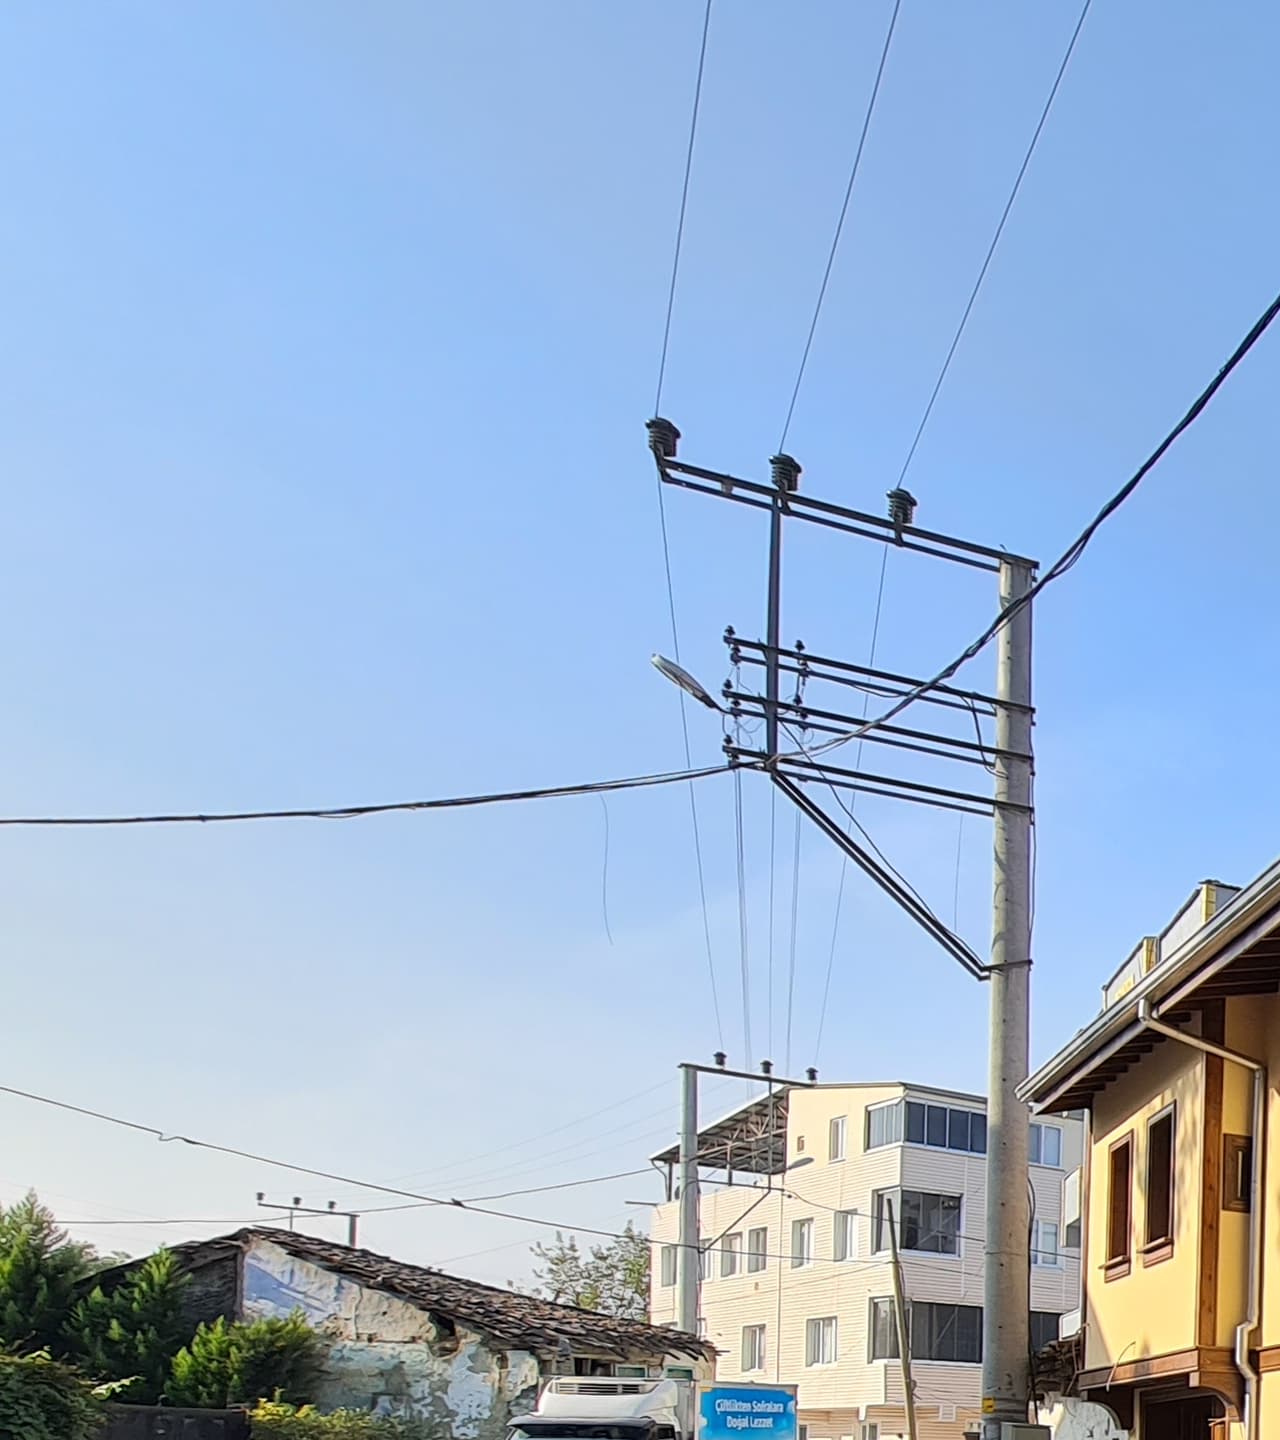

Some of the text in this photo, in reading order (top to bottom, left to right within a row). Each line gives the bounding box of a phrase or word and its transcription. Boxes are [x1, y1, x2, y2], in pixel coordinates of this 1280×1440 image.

[752, 1400, 784, 1413] Sofralara
[726, 1415, 773, 1430] Doğal Lezzet
